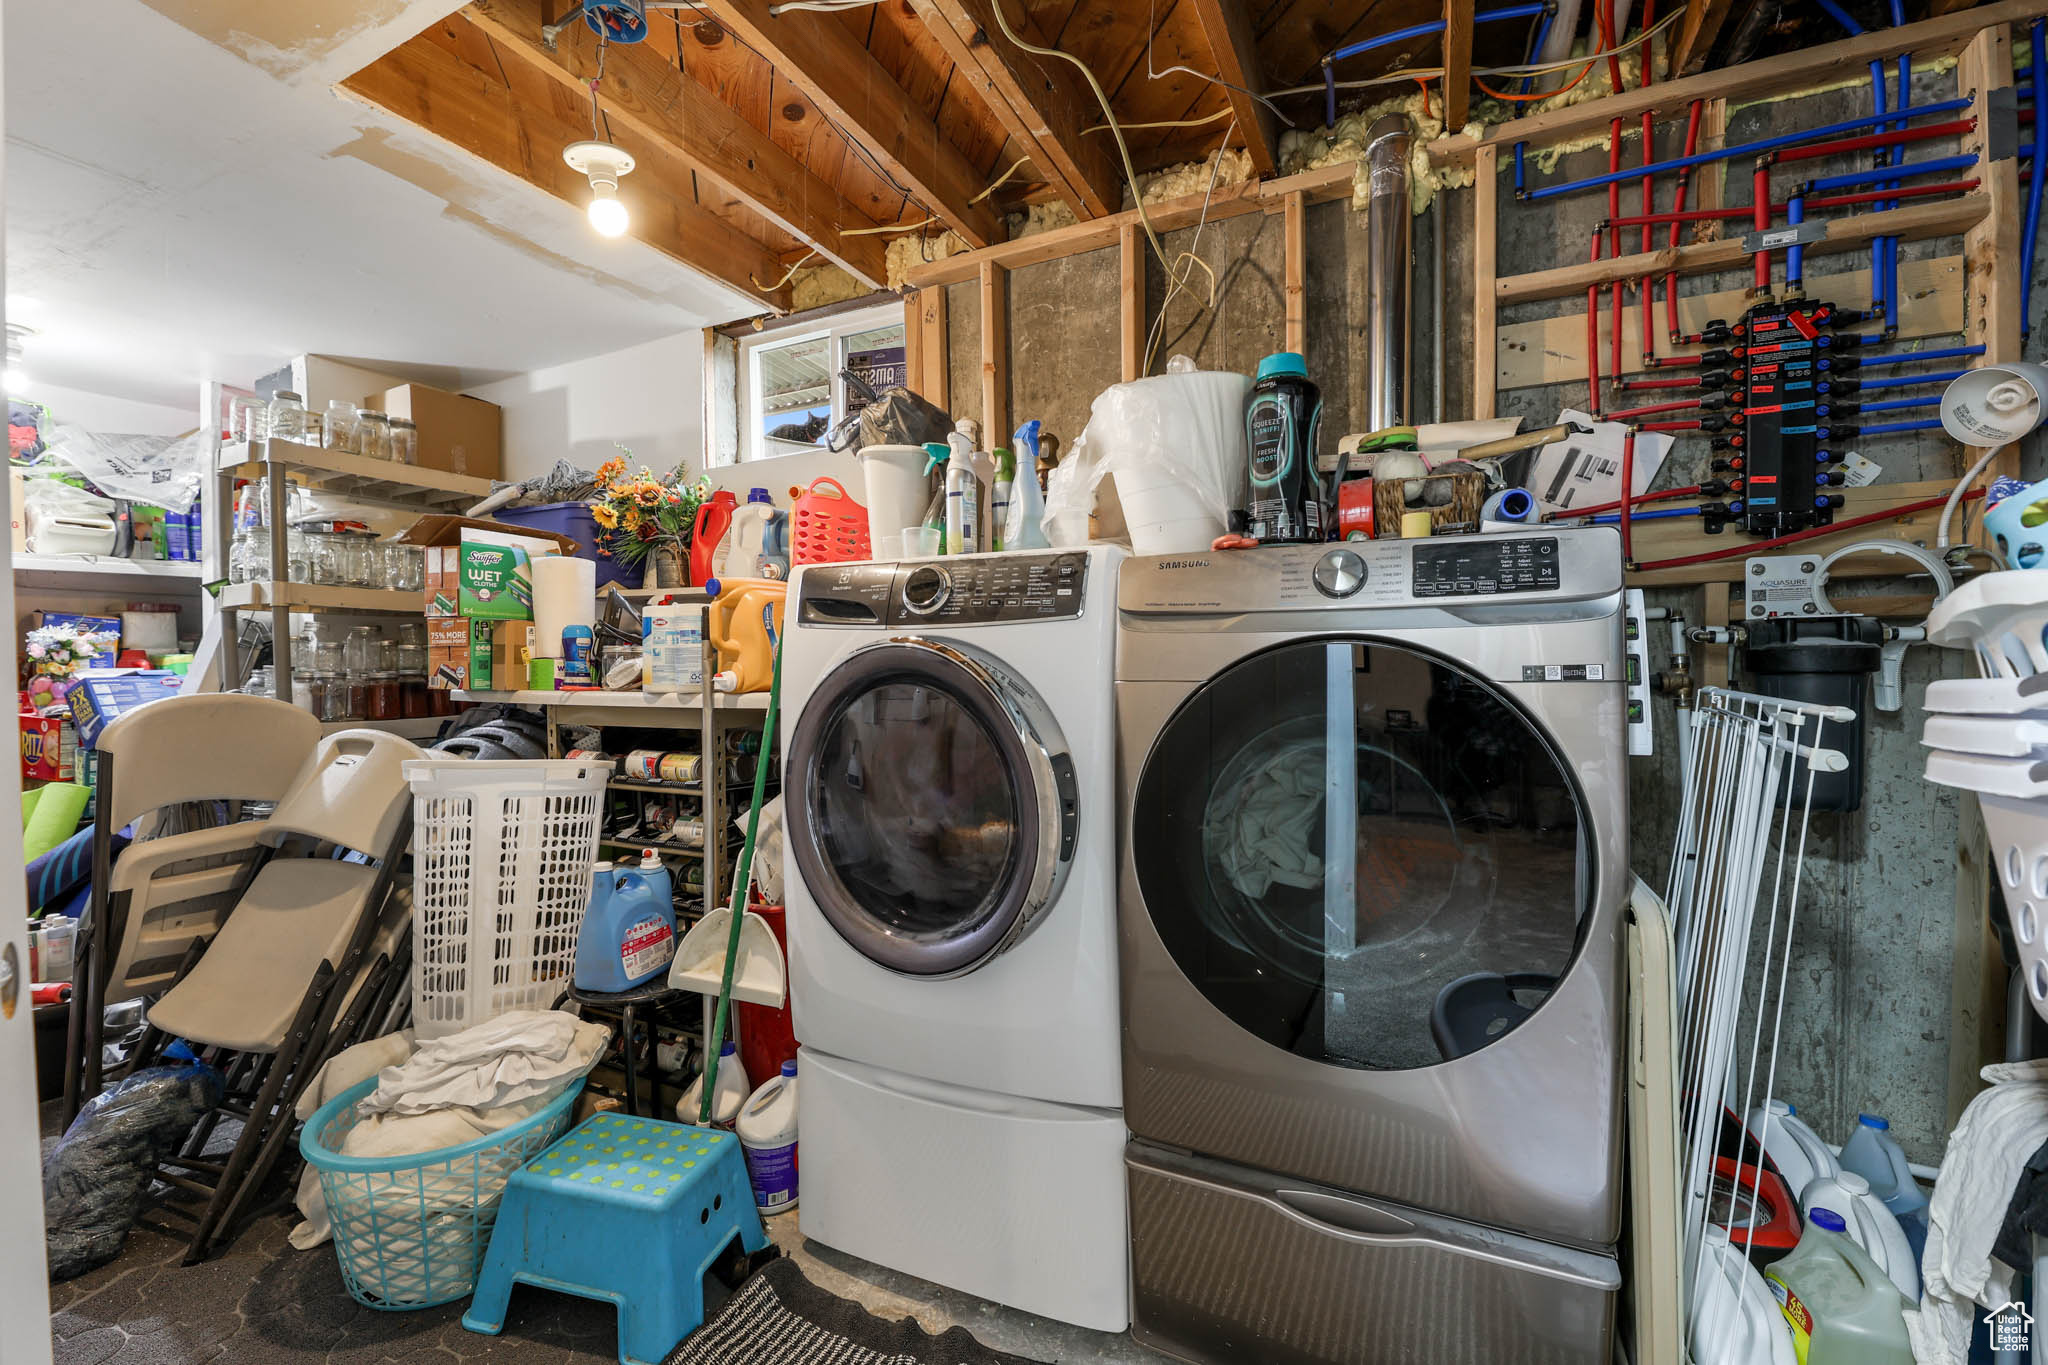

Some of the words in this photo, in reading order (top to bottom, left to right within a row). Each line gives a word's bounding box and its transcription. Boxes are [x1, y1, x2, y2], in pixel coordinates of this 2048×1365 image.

[1253, 419, 1280, 429] SQUEEZE
[1257, 447, 1277, 456] FRESH
[468, 551, 502, 565] Swiffer
[1159, 560, 1210, 570] SAMSUNG
[468, 568, 503, 582] WET
[1760, 579, 1808, 587] AQUASURE
[446, 631, 467, 639] MORE
[70, 690, 88, 709] 2X
[22, 731, 43, 757] RITZ
